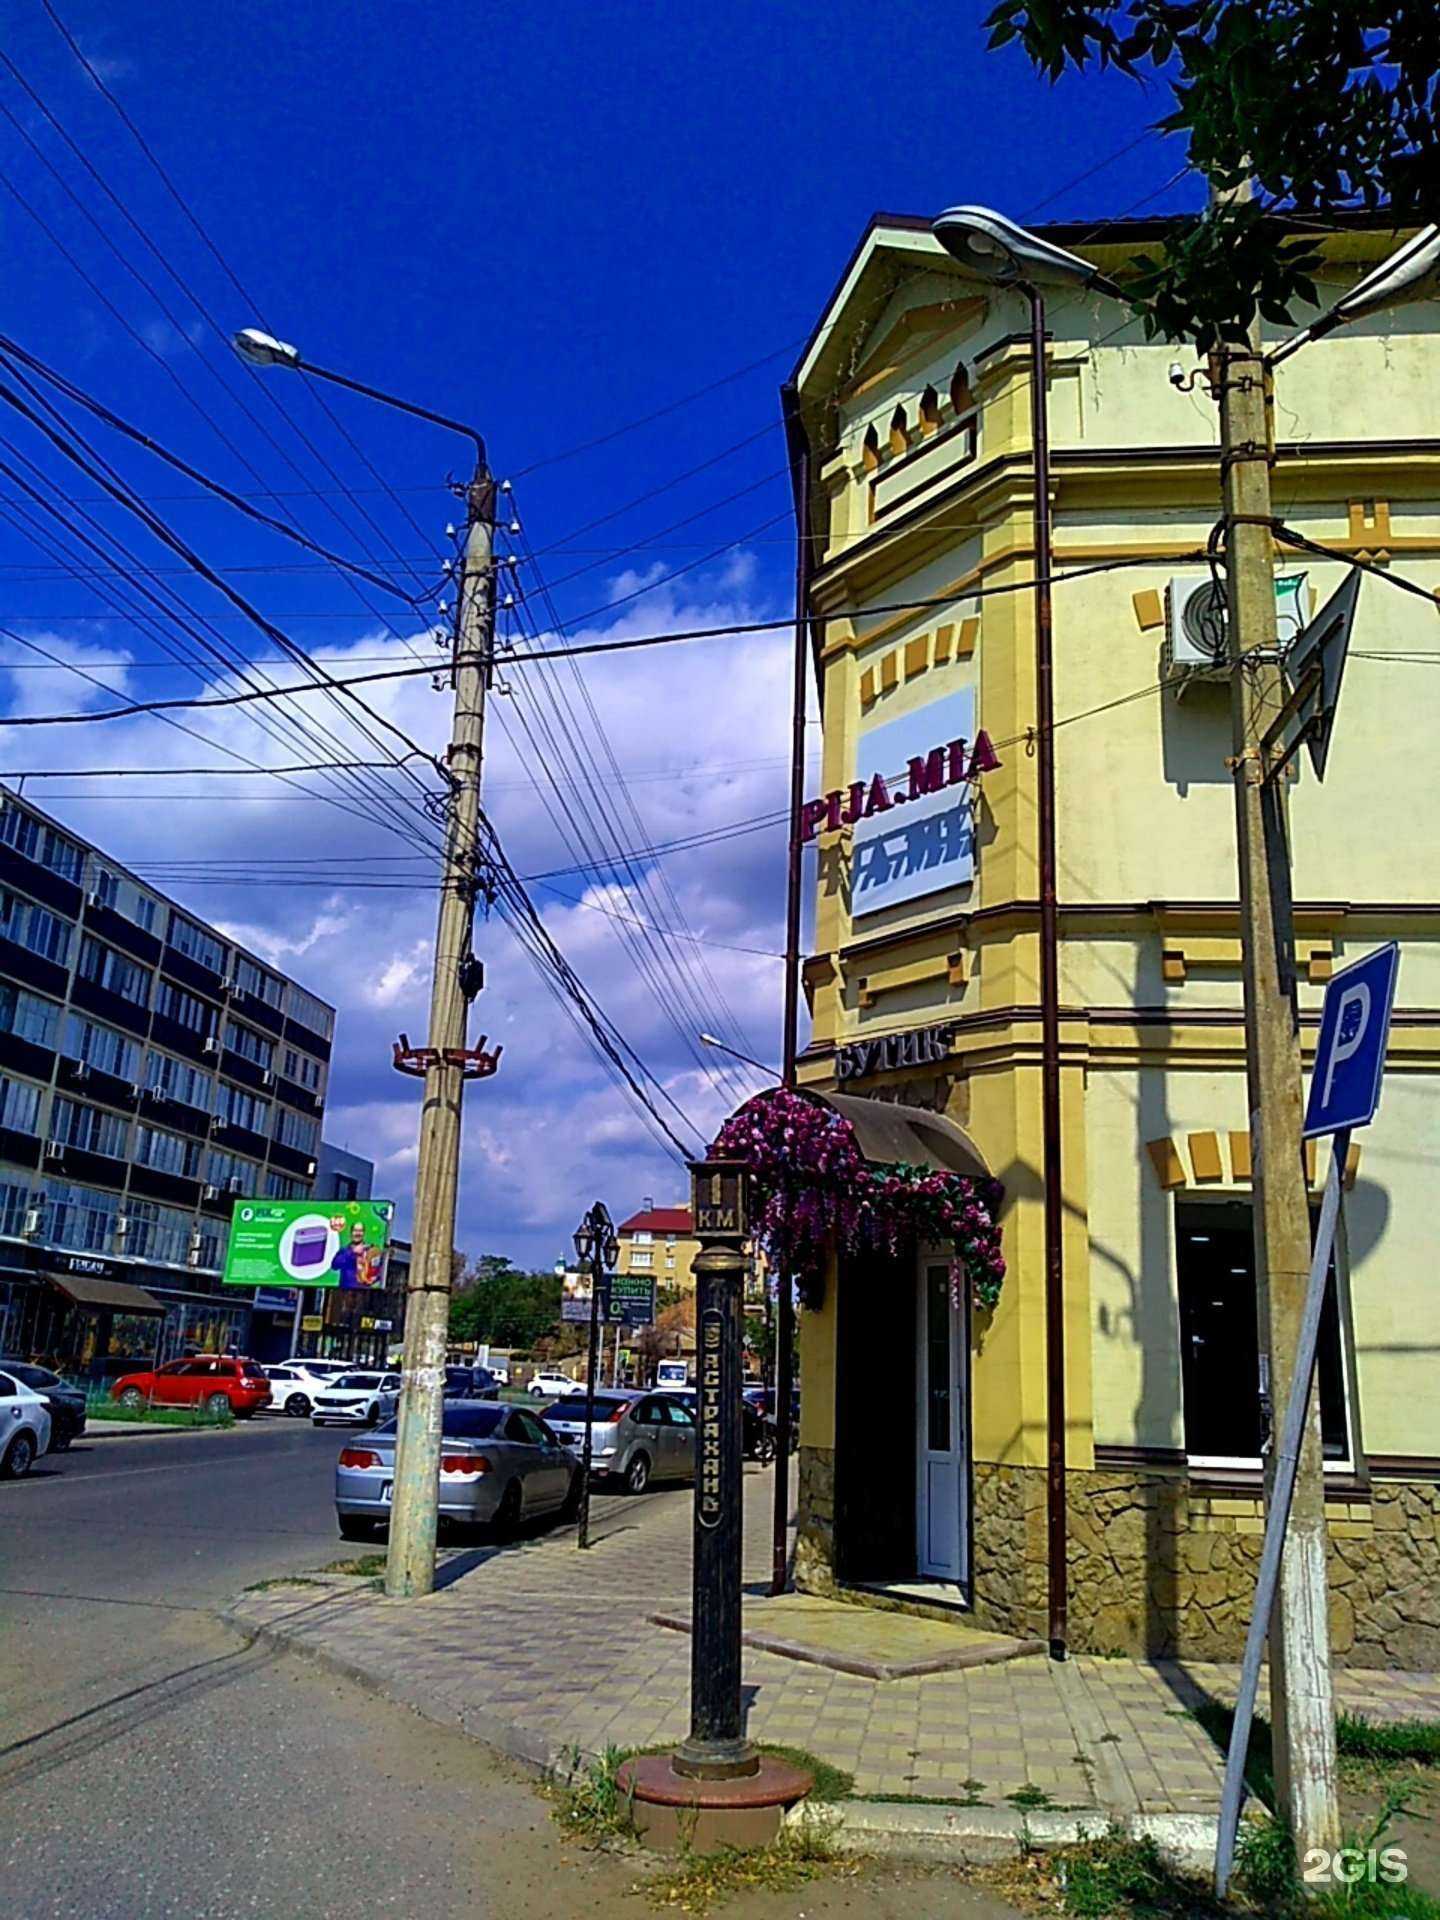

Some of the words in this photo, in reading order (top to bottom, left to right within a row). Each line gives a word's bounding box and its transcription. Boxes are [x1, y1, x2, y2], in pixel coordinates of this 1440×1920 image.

[801, 729, 1003, 843] PIJA.MIA
[834, 1026, 953, 1079] БУТИК
[1321, 982, 1371, 1109] P
[698, 1209, 734, 1228] КМ
[702, 1353, 720, 1512] АСТРАХАНЬ
